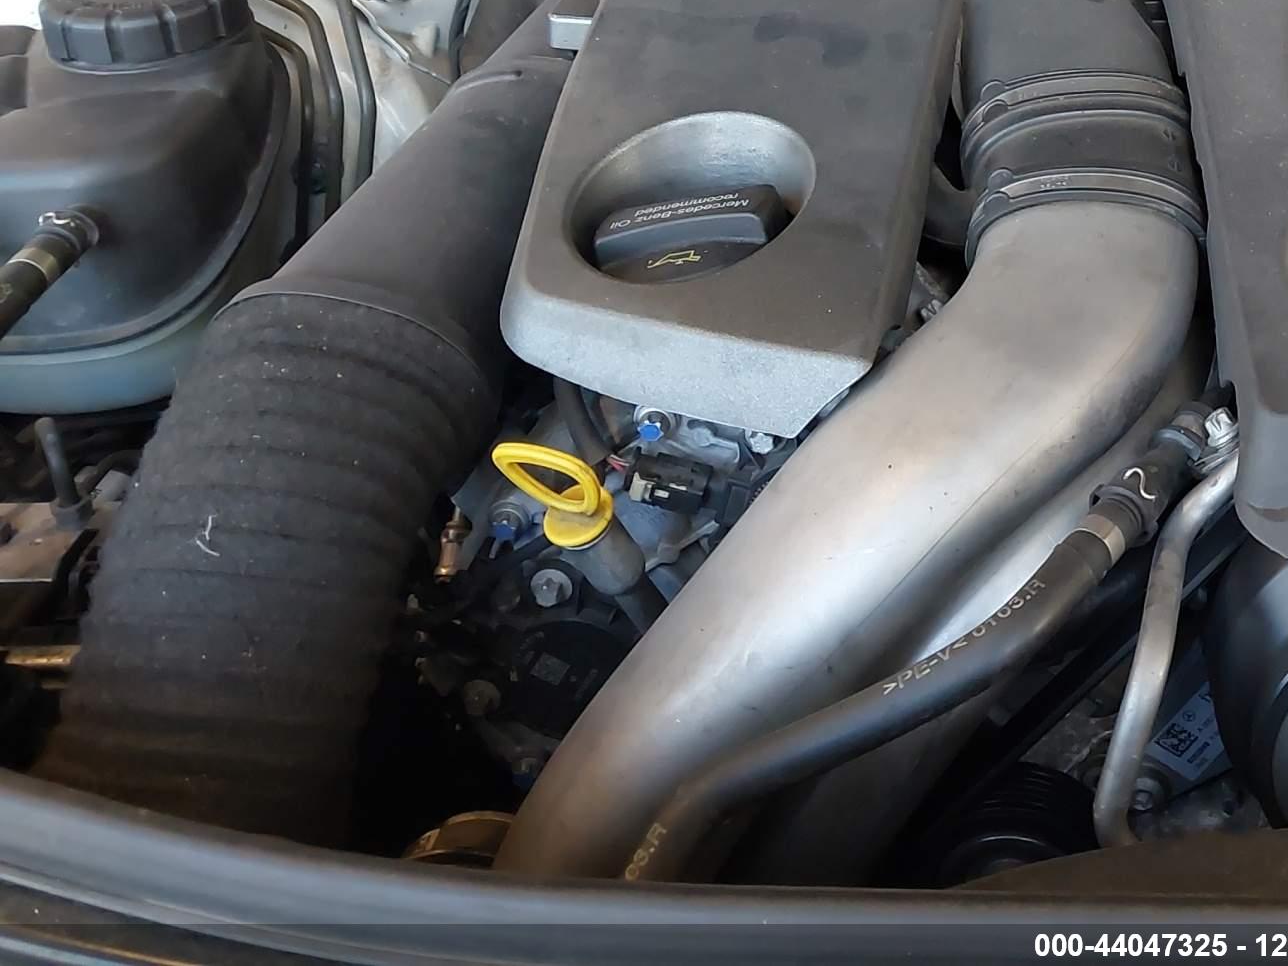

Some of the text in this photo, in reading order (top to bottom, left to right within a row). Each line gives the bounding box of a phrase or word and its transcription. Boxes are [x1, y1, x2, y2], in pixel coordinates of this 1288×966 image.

[610, 199, 749, 230] Mercedes-Benz Oil
[634, 192, 739, 217] recommended
